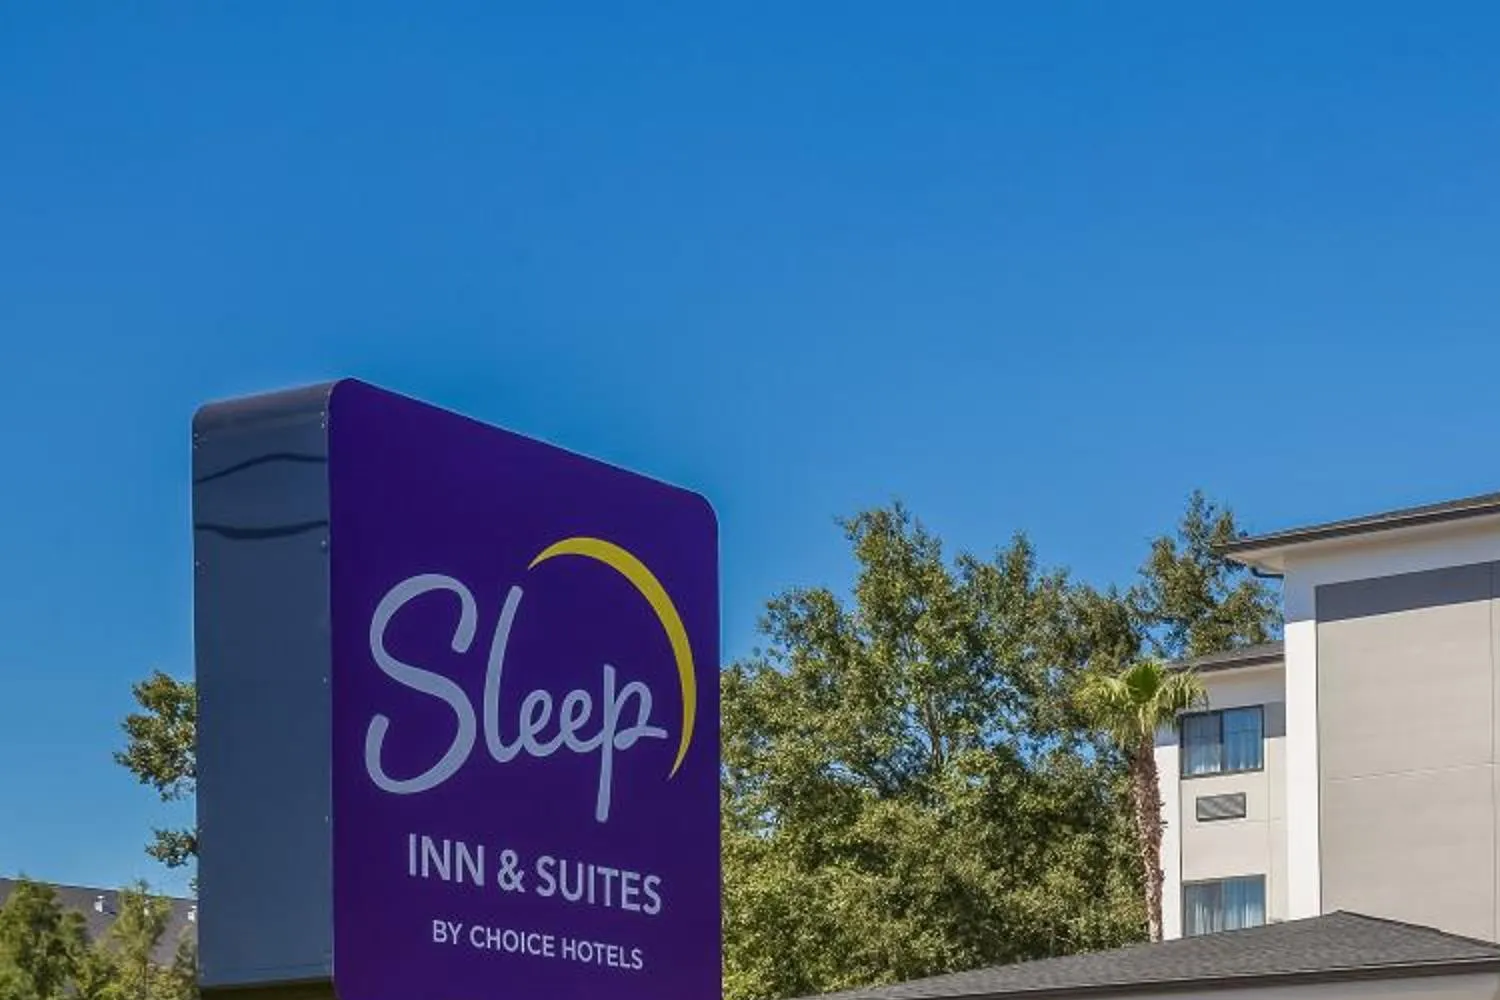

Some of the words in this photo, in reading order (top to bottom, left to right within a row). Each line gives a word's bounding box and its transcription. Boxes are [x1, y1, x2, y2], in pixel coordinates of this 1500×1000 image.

[364, 573, 668, 823] Sleep
[409, 833, 485, 886] INN
[497, 849, 526, 893] &
[535, 855, 662, 915] SUITES
[432, 919, 463, 945] BY
[469, 925, 556, 958] CHOICE
[561, 937, 644, 970] HOTELS
